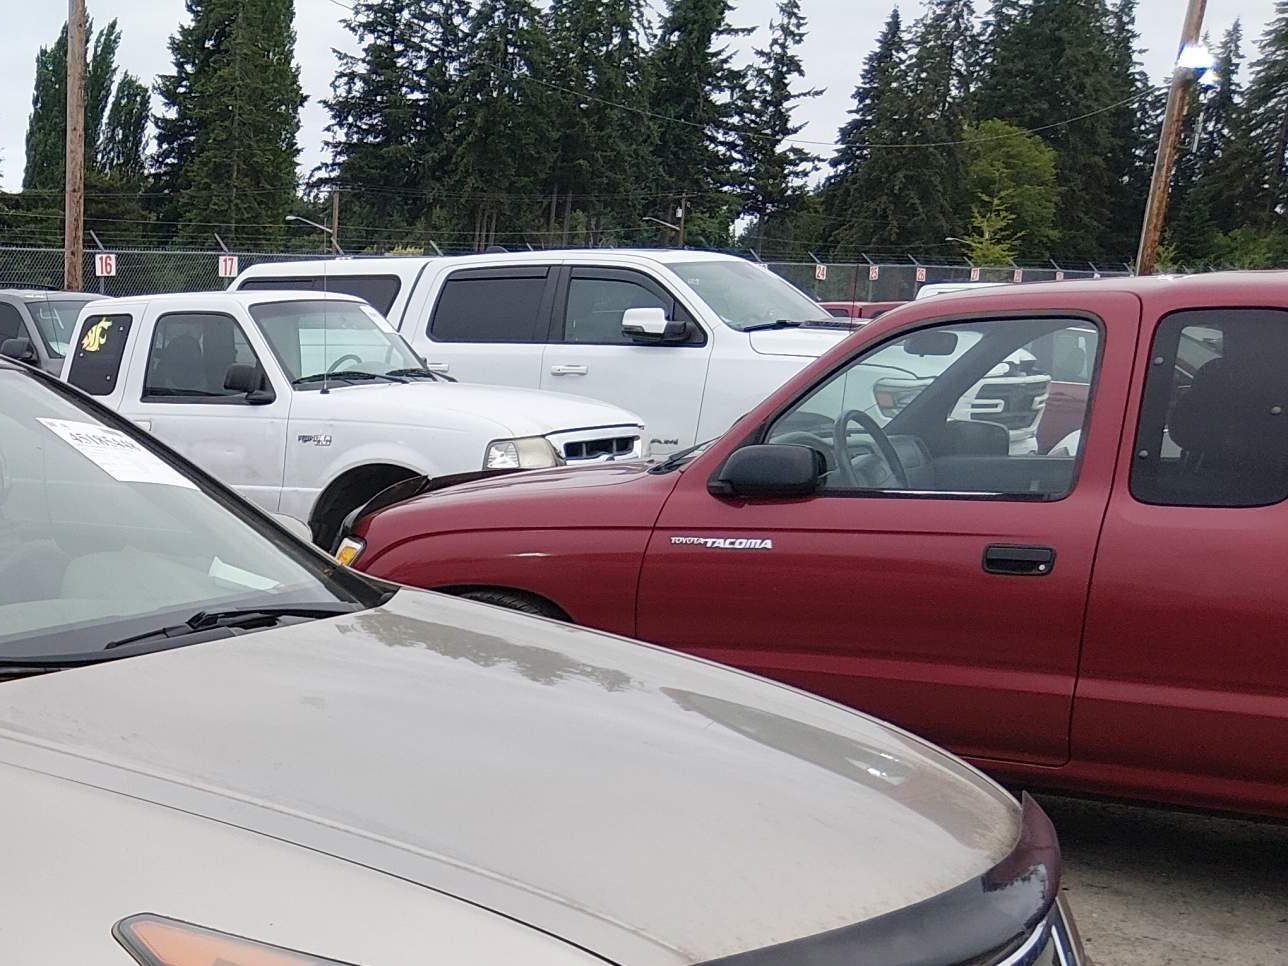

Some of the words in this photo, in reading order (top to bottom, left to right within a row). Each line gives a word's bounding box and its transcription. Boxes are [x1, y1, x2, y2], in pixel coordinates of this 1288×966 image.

[99, 255, 112, 274] 16
[223, 257, 234, 276] 17
[816, 266, 825, 279] 24
[870, 265, 878, 279] 25
[670, 536, 704, 544] TOYOTA
[702, 538, 772, 549] TACOMA
